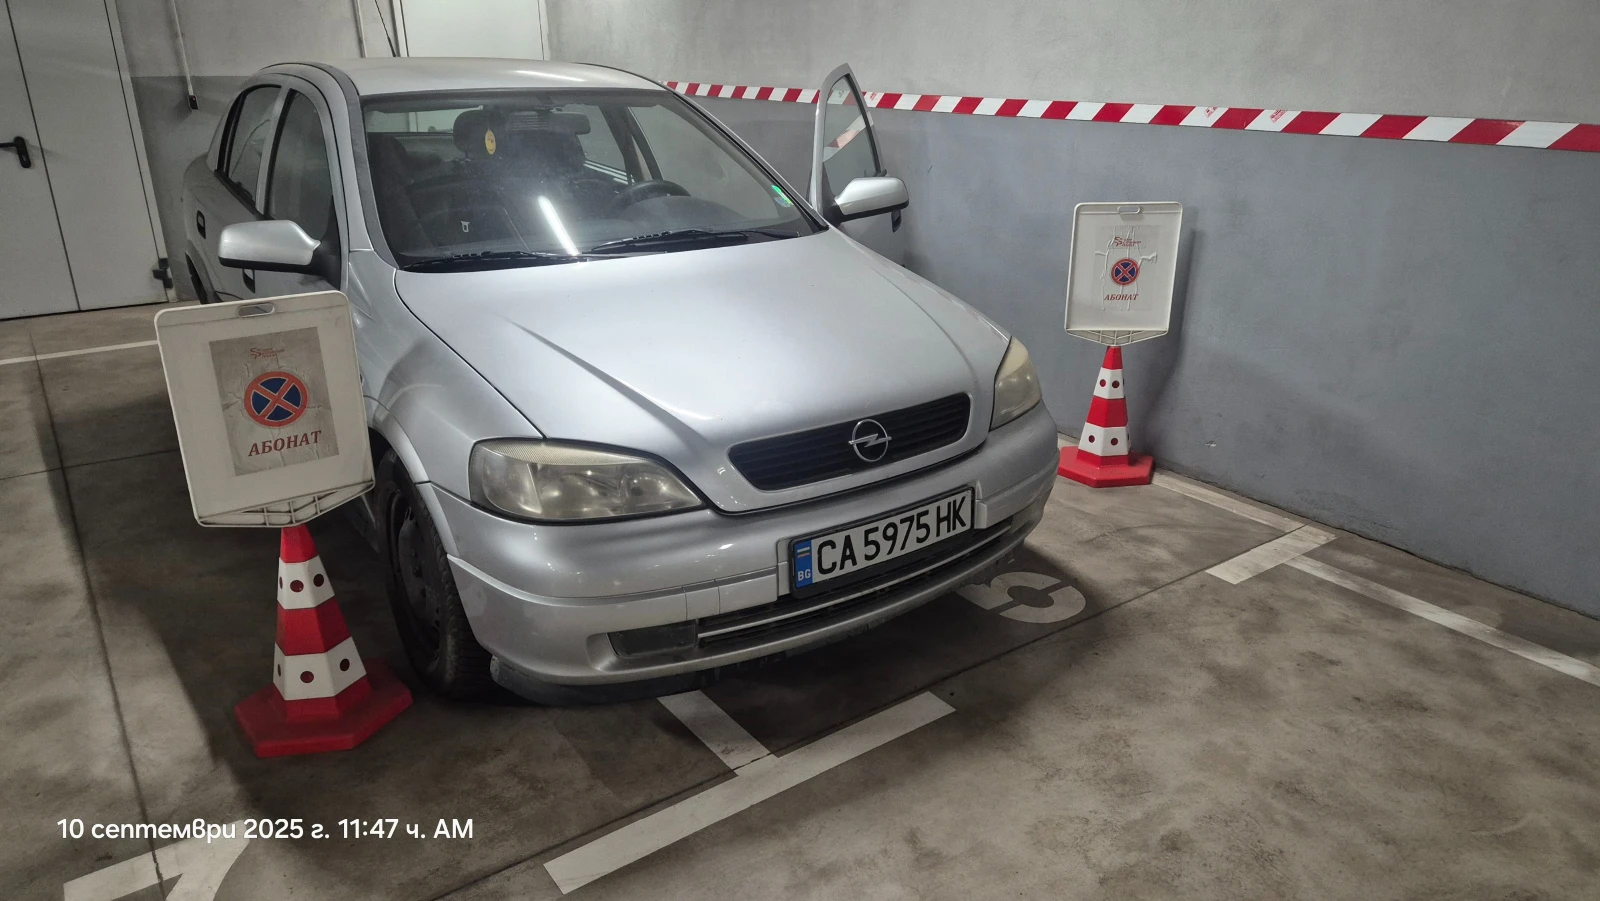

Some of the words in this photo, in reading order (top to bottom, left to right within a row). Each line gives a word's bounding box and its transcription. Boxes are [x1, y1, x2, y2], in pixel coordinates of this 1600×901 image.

[1104, 293, 1139, 301] АБОНАТ
[247, 430, 322, 457] АБОНАТ
[817, 534, 858, 575] CA
[864, 509, 931, 562] 5975
[936, 496, 967, 538] HK
[797, 568, 812, 582] BG
